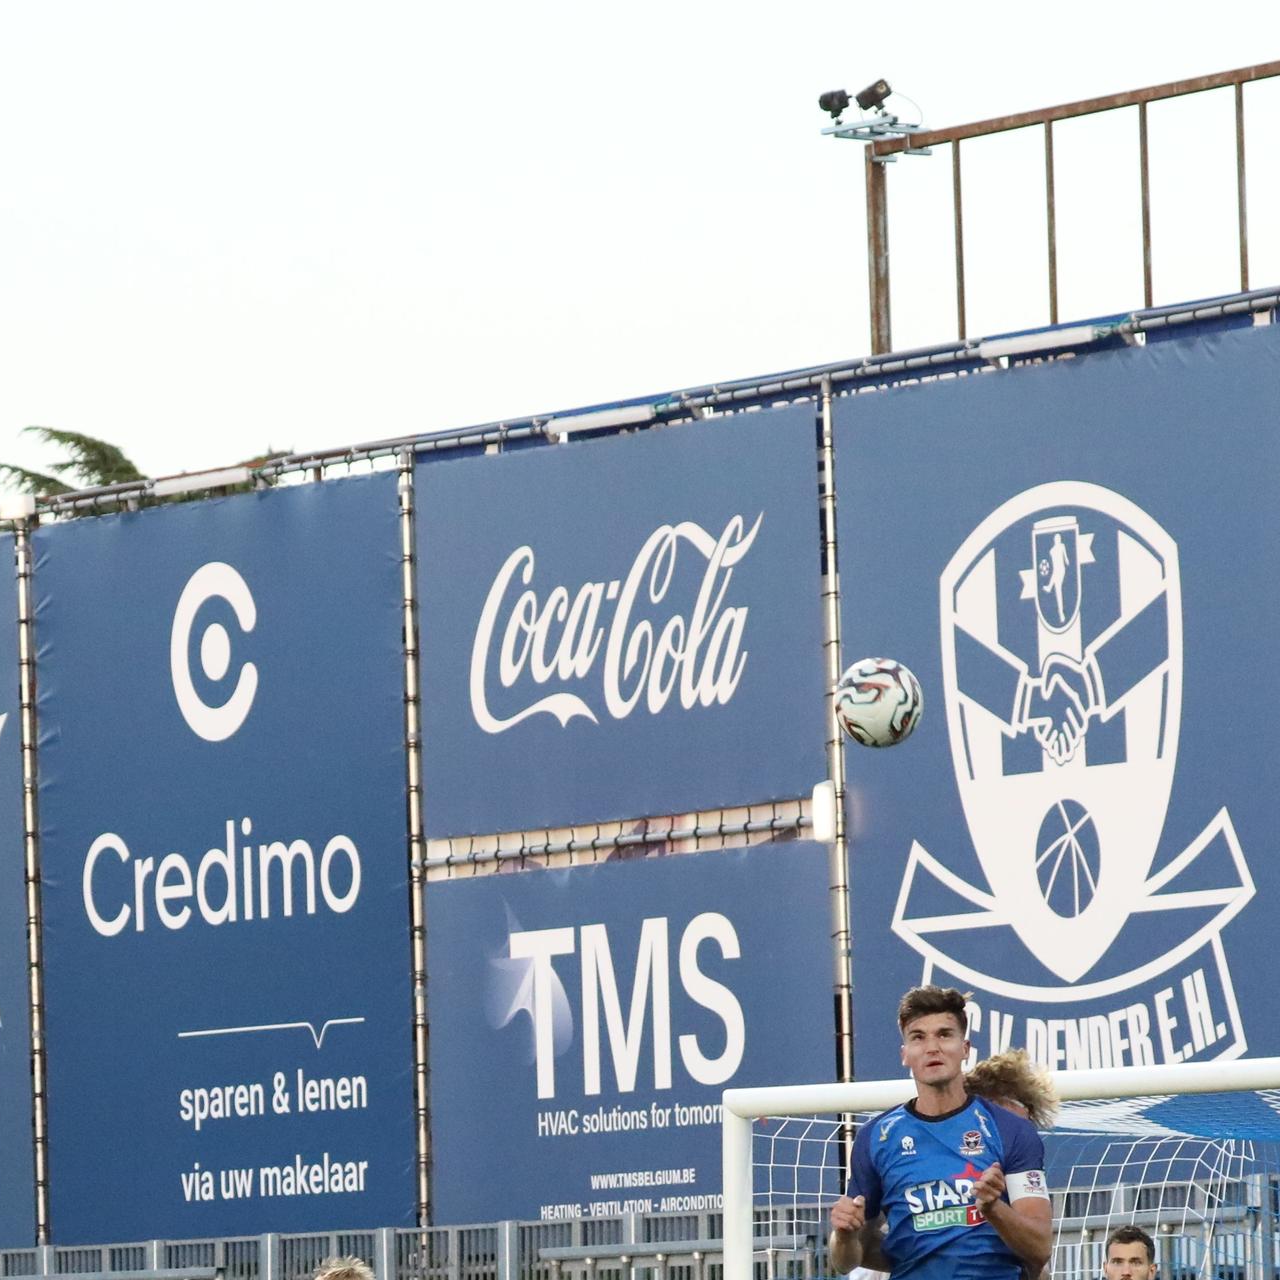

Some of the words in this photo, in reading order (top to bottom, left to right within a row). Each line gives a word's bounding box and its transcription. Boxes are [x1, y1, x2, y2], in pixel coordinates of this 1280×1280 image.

[470, 510, 765, 735] Coca-Cola
[82, 818, 362, 936] Credimo
[510, 912, 747, 1100] TMS
[1026, 1002, 1156, 1071] DENDER
[179, 1079, 265, 1131] sparen
[272, 1071, 290, 1114] &
[297, 1070, 368, 1114] lenen
[537, 1110, 579, 1137] HVAC
[582, 1107, 647, 1134] solutions
[651, 1102, 671, 1128] for
[181, 1165, 215, 1202] via
[221, 1166, 252, 1199] uw
[259, 1153, 368, 1198] makelaar
[591, 1168, 695, 1189] WWW.TMSBELGIUM.BE
[904, 1178, 976, 1215] STAR
[541, 1205, 582, 1220] HEATING
[589, 1199, 652, 1217] VENTILATION
[916, 1209, 965, 1228] SPORT
